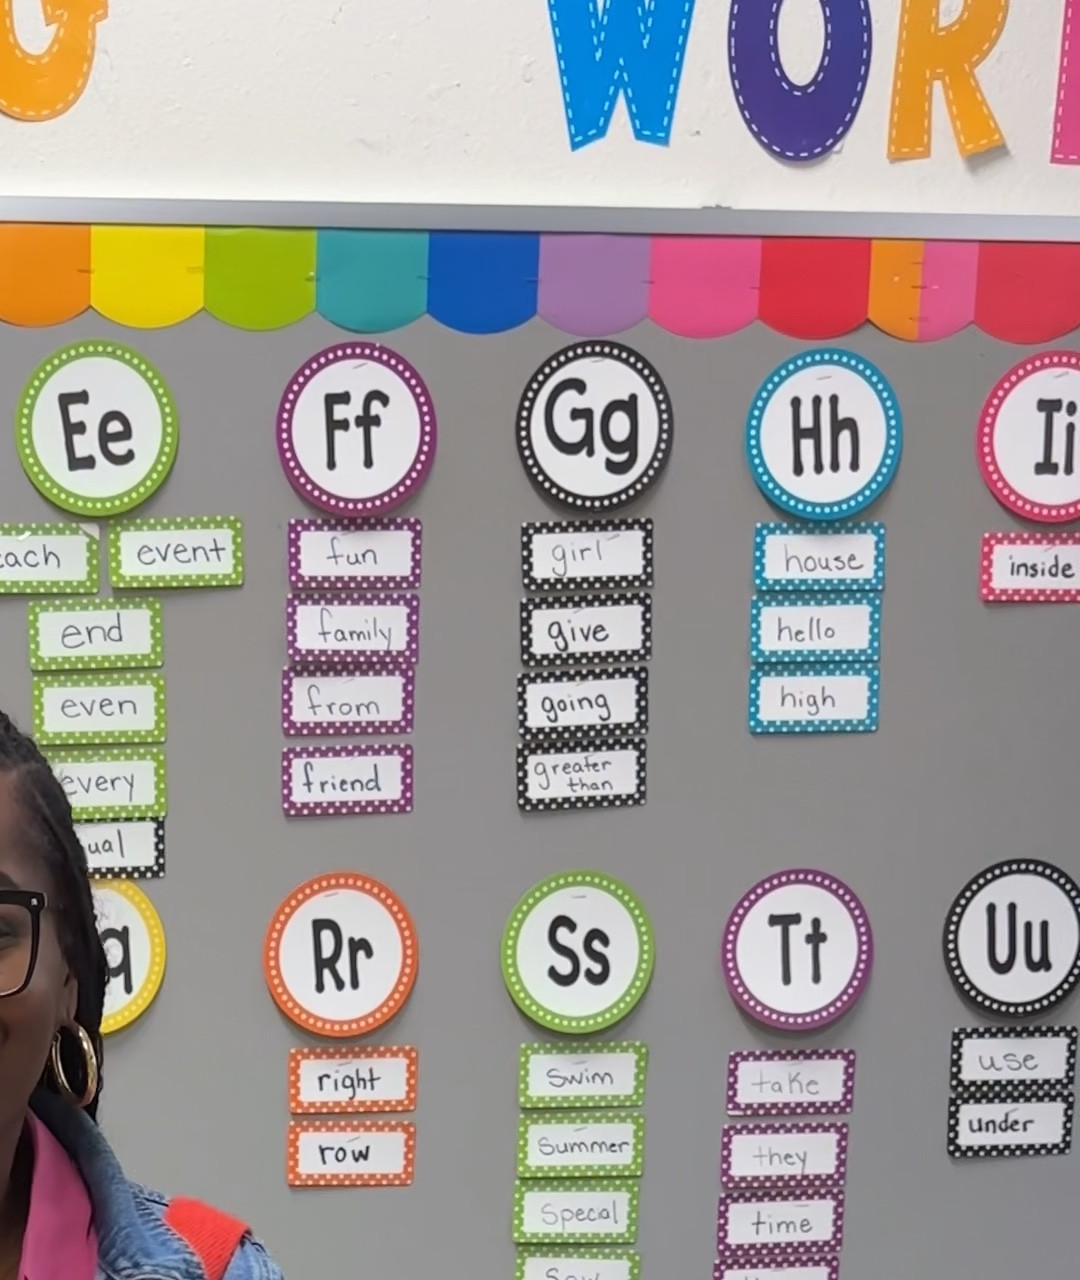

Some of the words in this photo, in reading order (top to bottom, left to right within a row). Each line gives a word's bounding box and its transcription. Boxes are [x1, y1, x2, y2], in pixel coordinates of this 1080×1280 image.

[546, 0, 1080, 166] WOR
[57, 388, 136, 473] Ee
[323, 389, 391, 472] Ff
[543, 377, 638, 475] Gg
[789, 393, 860, 477] Hh
[1033, 397, 1078, 477] Ii
[136, 537, 227, 566] event
[326, 537, 378, 565] fun
[551, 540, 603, 577] girl
[785, 544, 865, 573] house
[1010, 554, 1076, 579] inside
[60, 612, 123, 649] end
[318, 608, 393, 651] family
[548, 621, 610, 652] give
[777, 615, 836, 644] hello
[60, 697, 138, 719] even
[306, 683, 381, 717] from
[541, 694, 612, 723] going
[780, 684, 836, 717] high
[62, 774, 135, 802] every
[302, 760, 382, 794] friend
[534, 758, 612, 790] greater
[567, 777, 614, 793] than
[547, 914, 611, 988] Ss
[767, 912, 829, 986] Tt
[985, 901, 1053, 976] Uu
[310, 917, 374, 995] Rr
[978, 1052, 1040, 1073] use
[318, 1069, 380, 1100] right
[967, 1113, 1035, 1134] under
[317, 1144, 371, 1165] row
[753, 1148, 807, 1172] they
[750, 1210, 813, 1236] time
